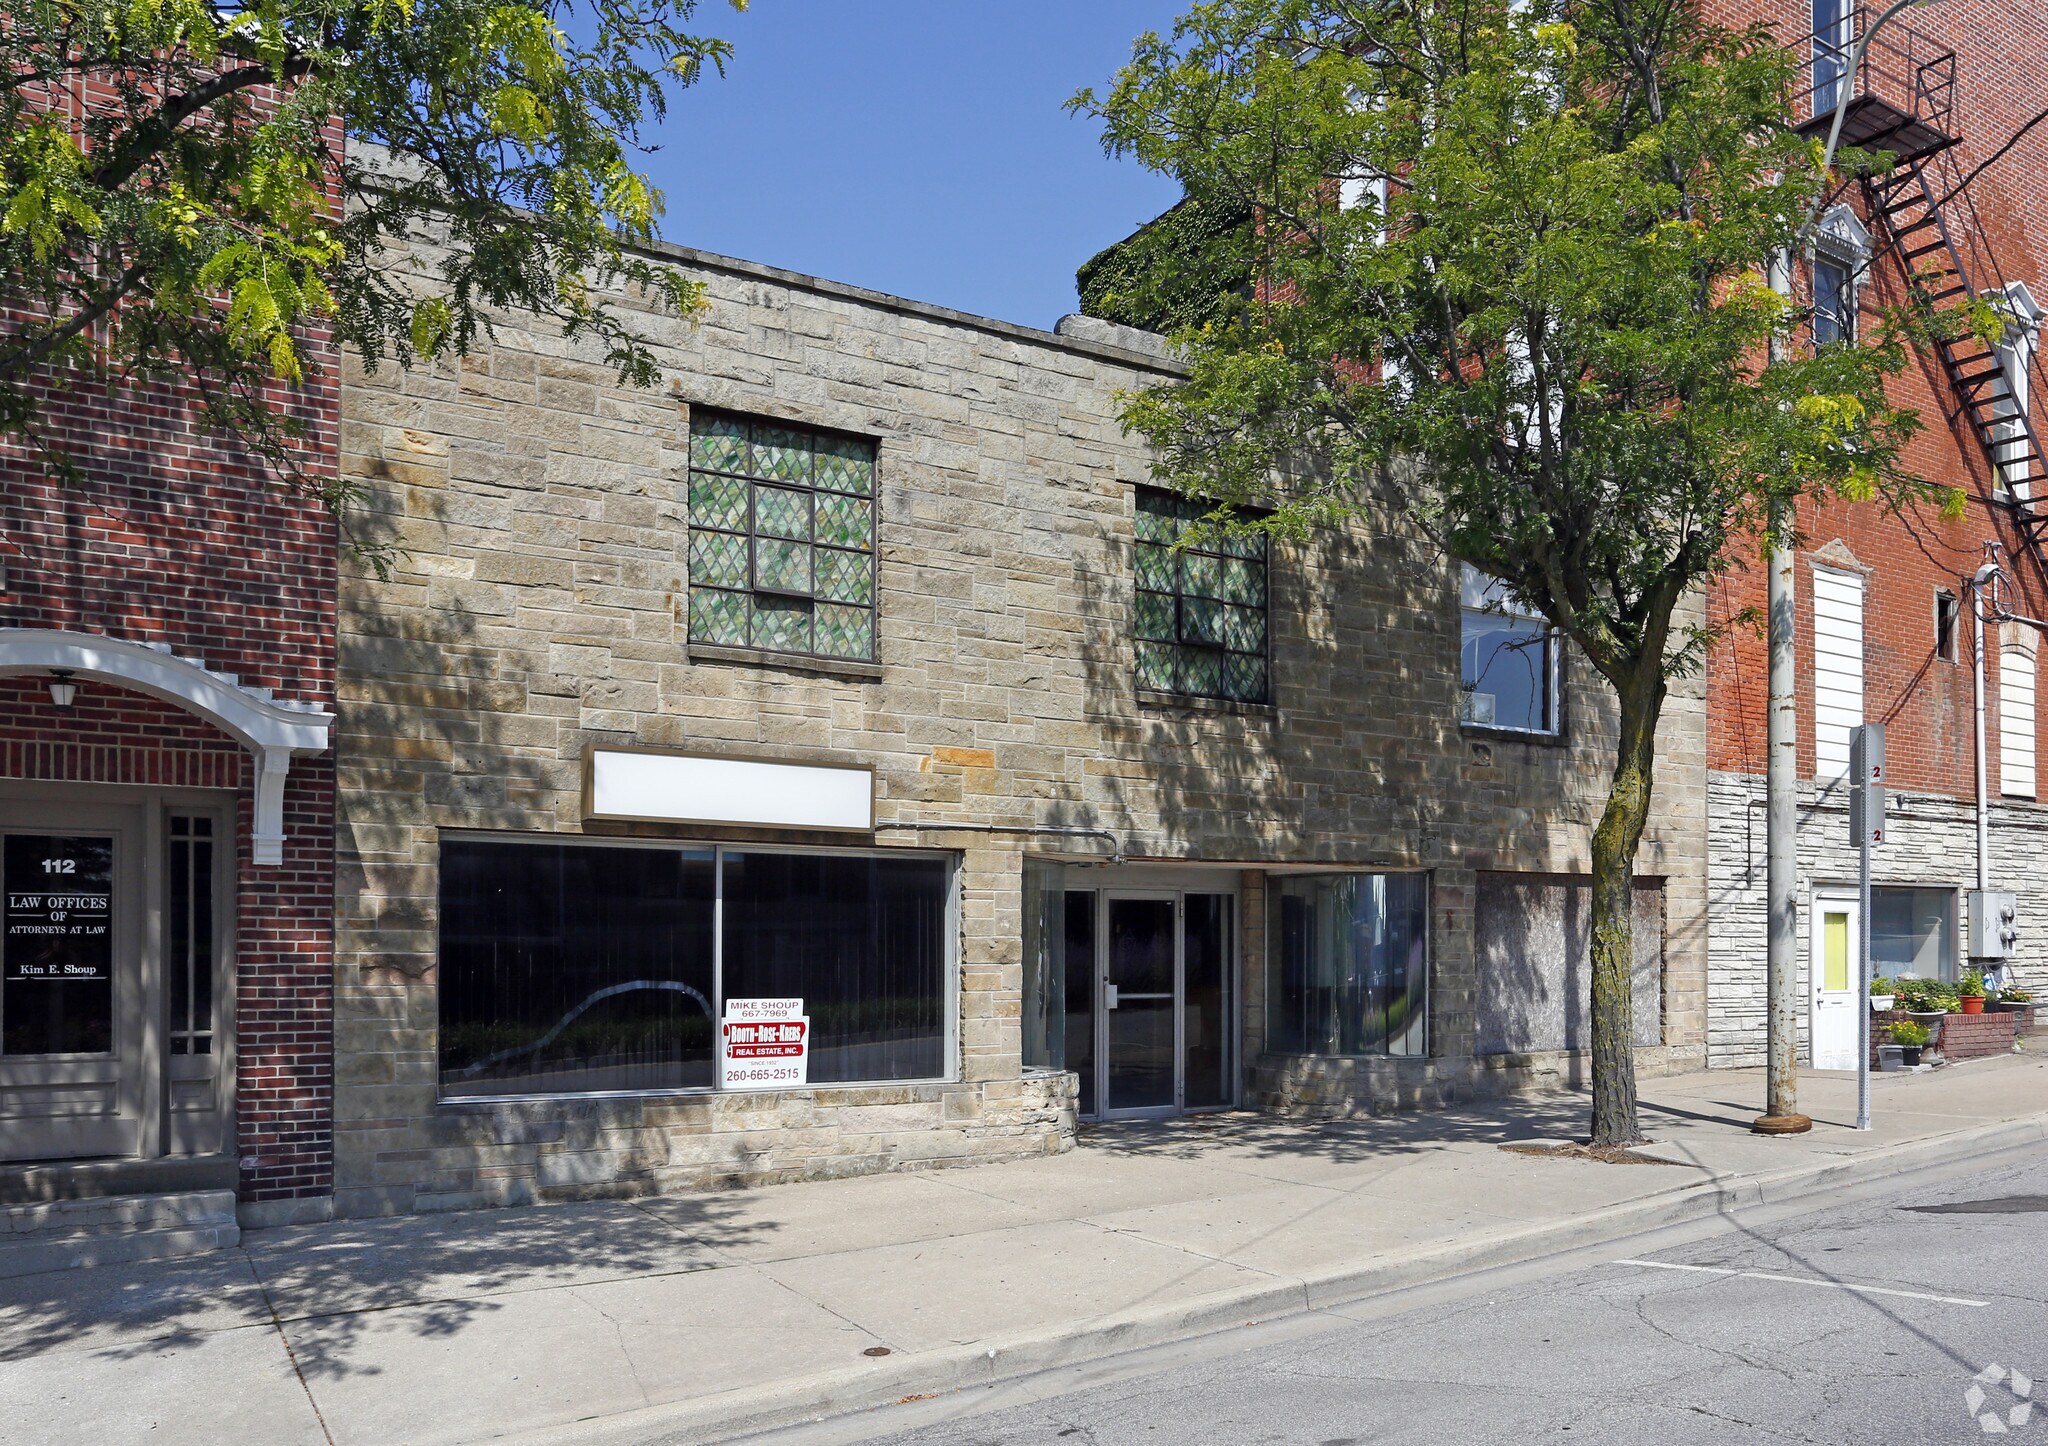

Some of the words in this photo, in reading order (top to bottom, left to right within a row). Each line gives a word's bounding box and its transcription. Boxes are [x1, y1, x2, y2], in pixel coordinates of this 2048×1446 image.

[1873, 766, 1881, 777] 2
[1873, 830, 1881, 841] 2
[41, 859, 76, 874] 112
[10, 896, 41, 908] LAW
[47, 897, 107, 909] OFFICES
[50, 911, 68, 921] OF
[9, 925, 66, 934] ATTORNEYS
[69, 926, 82, 934] AT
[86, 926, 106, 934] LAW
[20, 965, 44, 974] Kim
[49, 965, 60, 974] E.
[64, 965, 96, 975] Shoup
[730, 1002, 758, 1010] MIKE
[742, 1010, 788, 1018] 667-7969
[756, 1047, 784, 1056] ESTATE,
[784, 1047, 799, 1055] INC.
[726, 1068, 799, 1081] 260-665-2515
